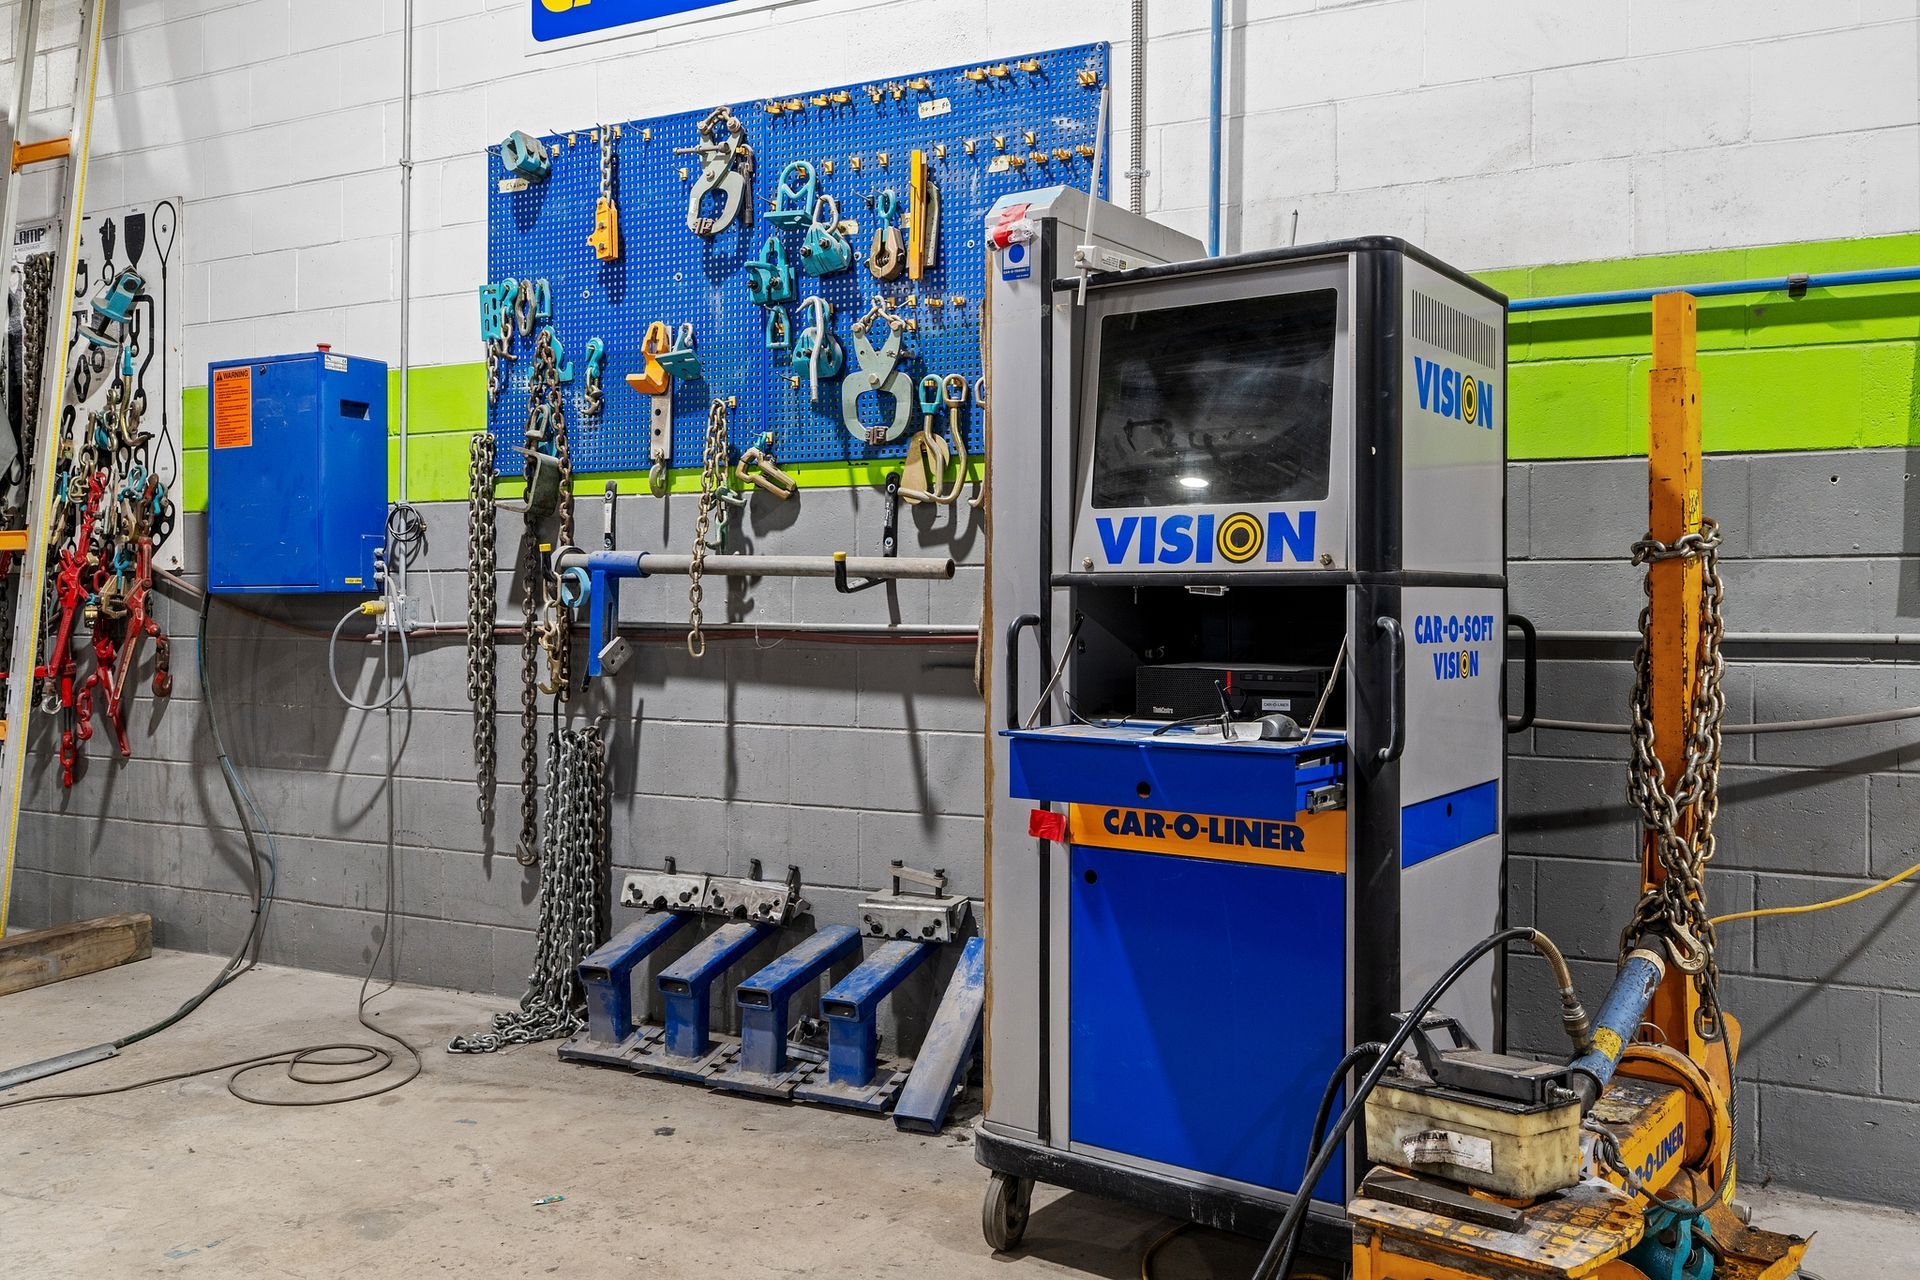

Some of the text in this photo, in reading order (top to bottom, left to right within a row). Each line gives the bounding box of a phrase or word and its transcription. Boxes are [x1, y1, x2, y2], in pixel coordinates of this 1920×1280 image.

[223, 370, 249, 379] WARNING
[1414, 355, 1493, 430] VISION
[1095, 510, 1317, 565] VISION
[1414, 614, 1494, 645] CAR-O-SOFT
[1433, 649, 1479, 681] VISION
[1103, 808, 1306, 853] CAR-O-LINER
